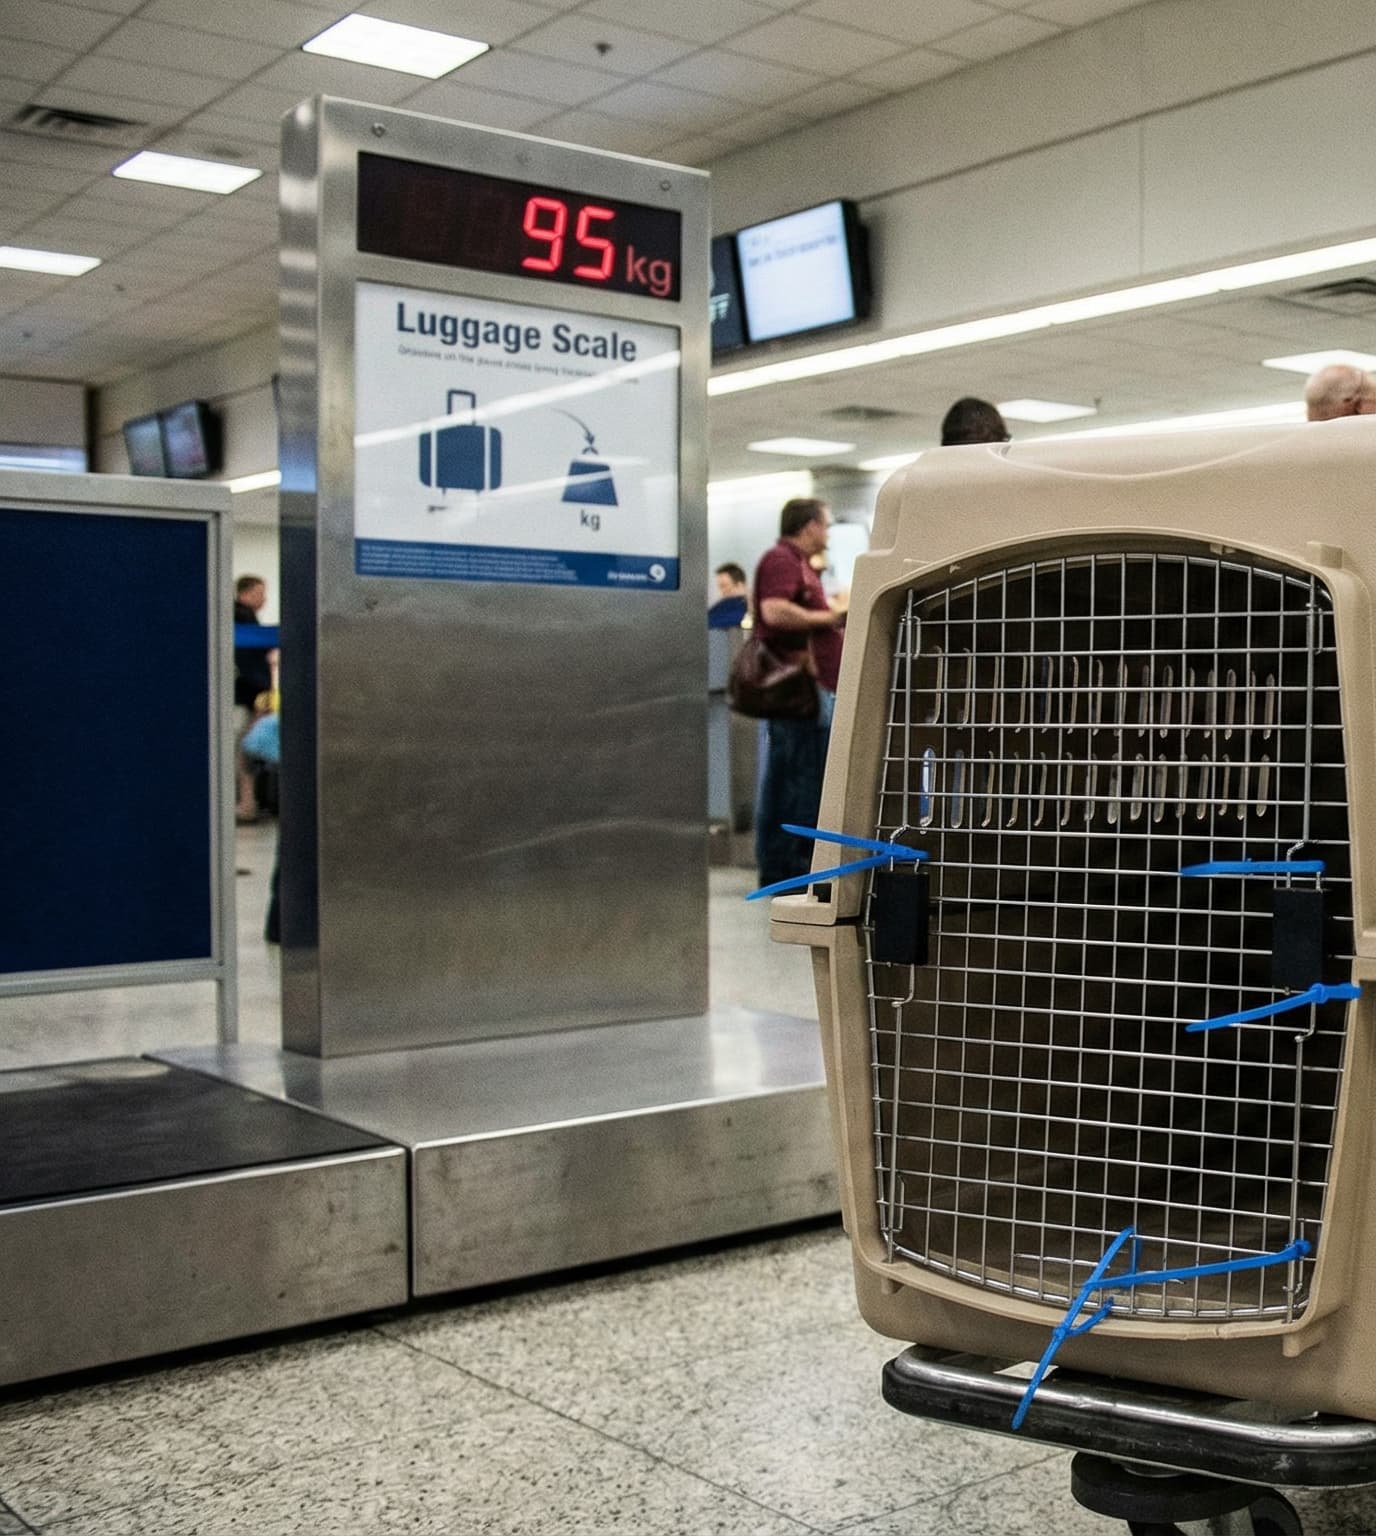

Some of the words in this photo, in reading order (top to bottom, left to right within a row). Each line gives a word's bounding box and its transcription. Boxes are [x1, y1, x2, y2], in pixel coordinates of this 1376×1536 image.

[521, 196, 616, 281] 95
[626, 244, 672, 297] kg
[397, 301, 541, 354] Luggage
[552, 323, 637, 363] Scale
[580, 509, 601, 532] kg
